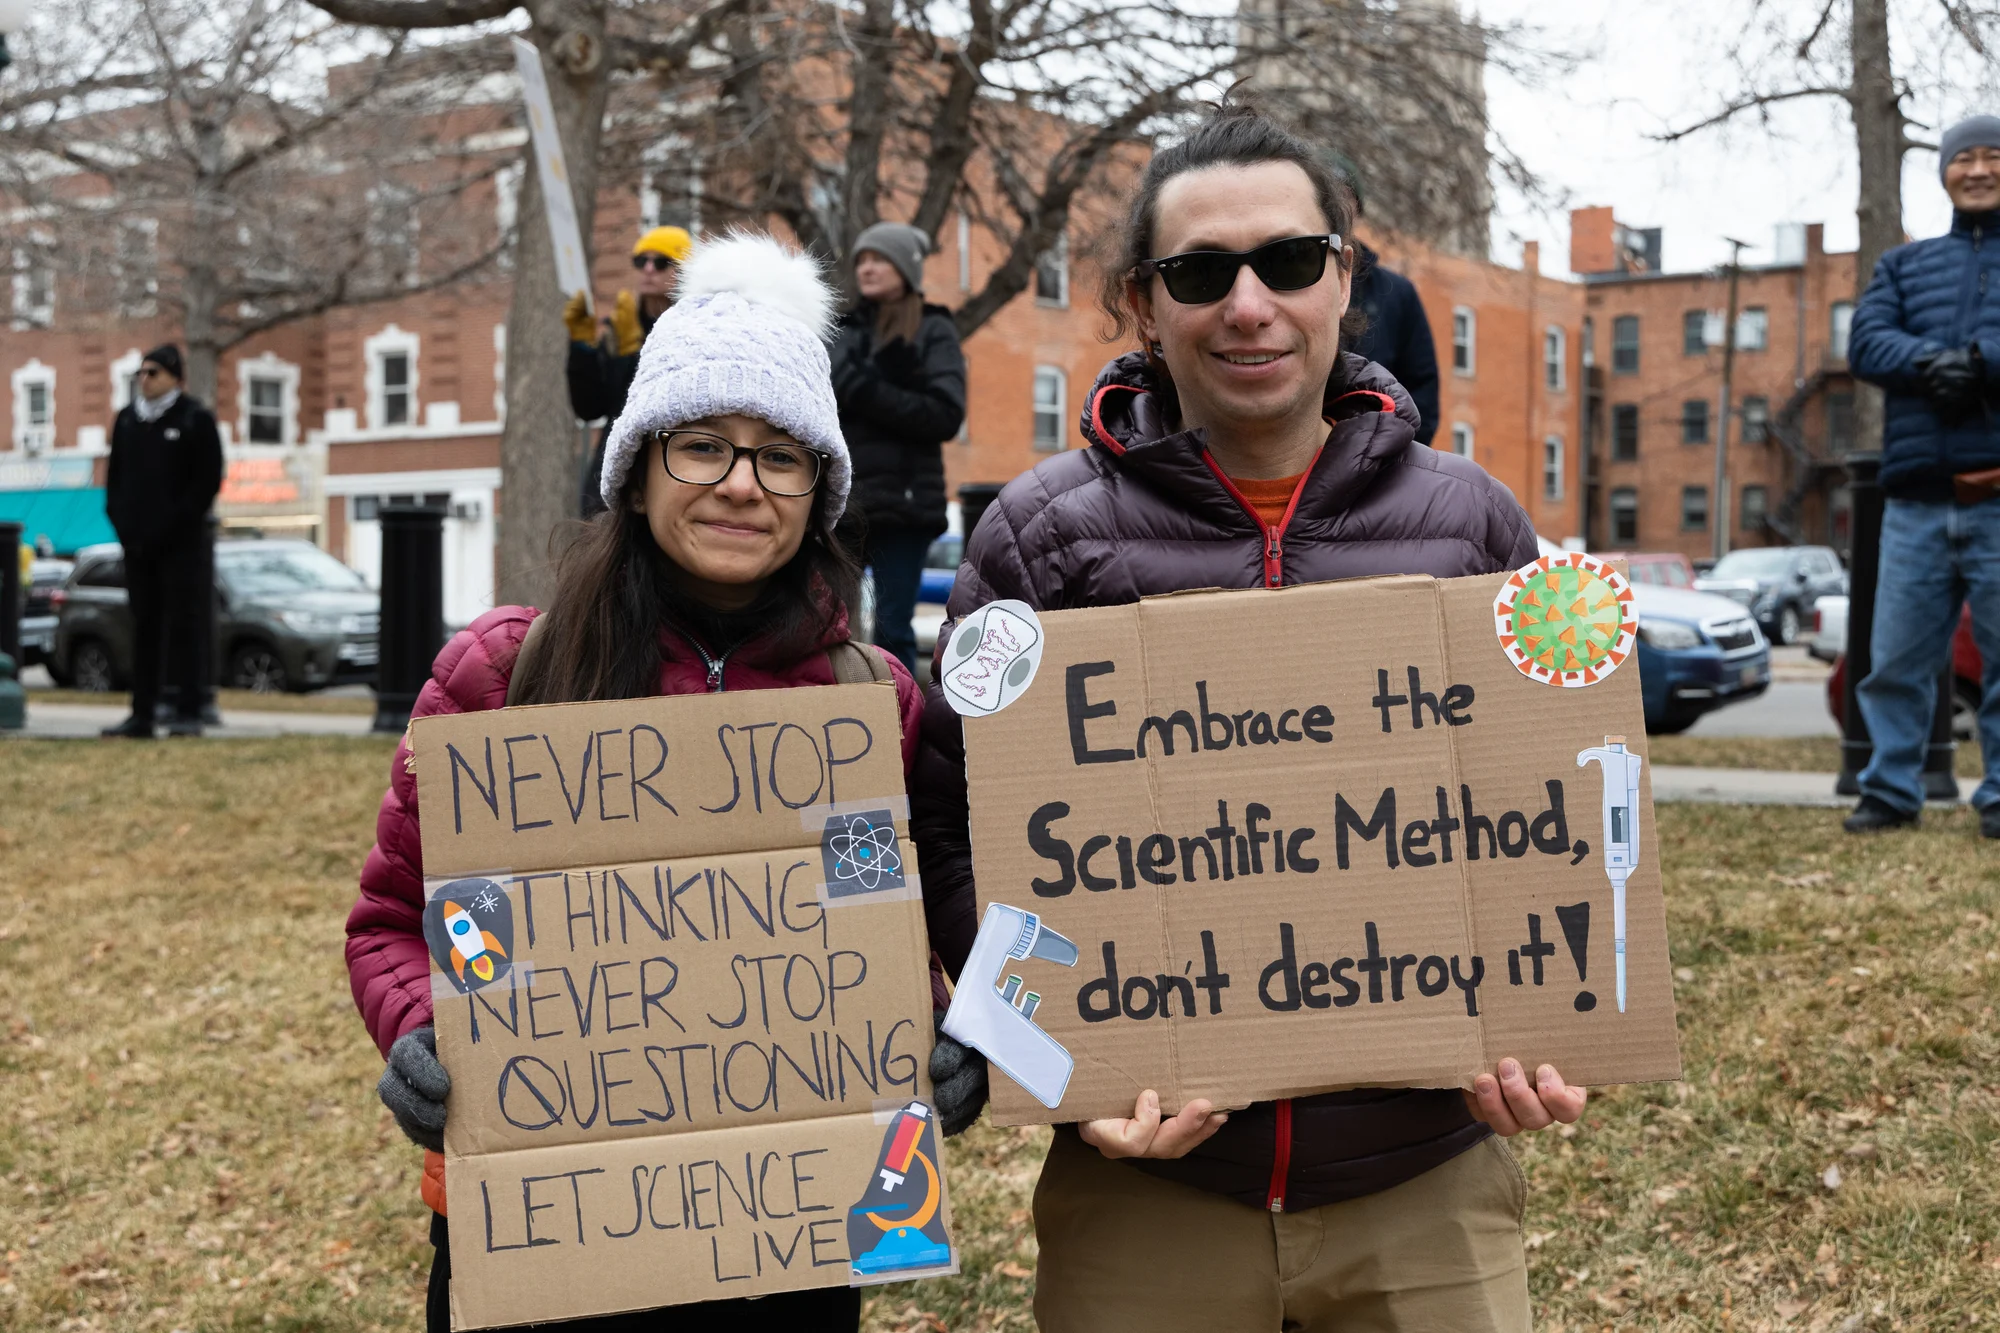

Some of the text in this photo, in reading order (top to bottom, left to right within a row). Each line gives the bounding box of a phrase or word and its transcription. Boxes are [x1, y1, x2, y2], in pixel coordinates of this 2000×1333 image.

[1066, 661, 1474, 765] Embrace the
[446, 718, 872, 834] NEVER STOP
[1028, 780, 1589, 897] Scientific Method,
[502, 862, 827, 950] THINKING
[468, 951, 867, 1044] NEVER STOP
[1077, 902, 1596, 1022] don't destroy it!
[498, 1019, 917, 1130] QUESTIONING
[481, 1149, 836, 1253] LET SCIENCE
[712, 1219, 850, 1282] LIVE
